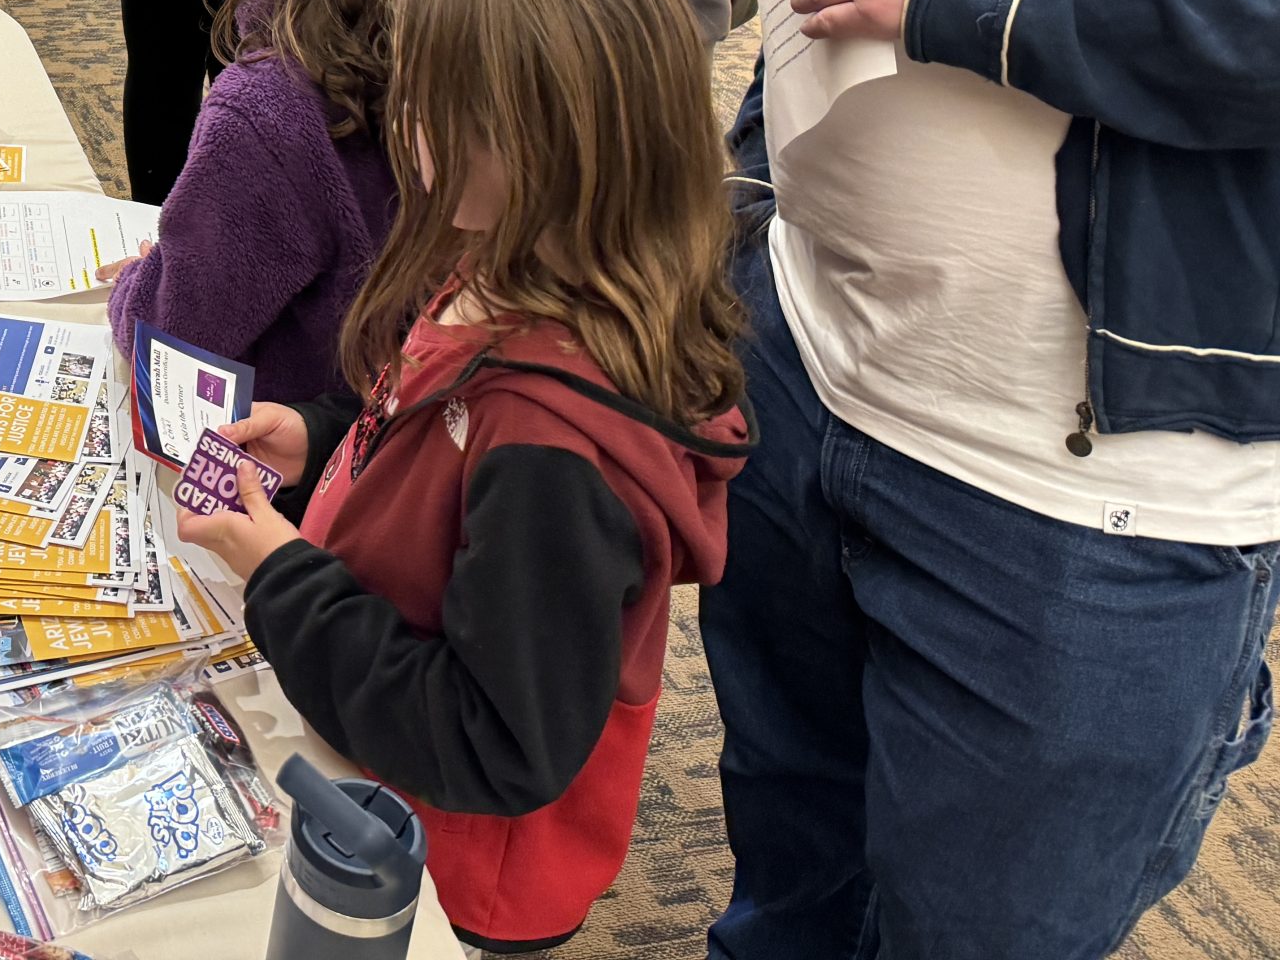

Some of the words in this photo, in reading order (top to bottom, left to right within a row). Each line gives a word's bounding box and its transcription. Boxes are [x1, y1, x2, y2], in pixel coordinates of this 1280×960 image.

[6, 404, 34, 446] JUSTICE
[186, 453, 243, 507] ORE
[92, 739, 114, 754] FRUIT
[122, 712, 186, 749] NUTRI
